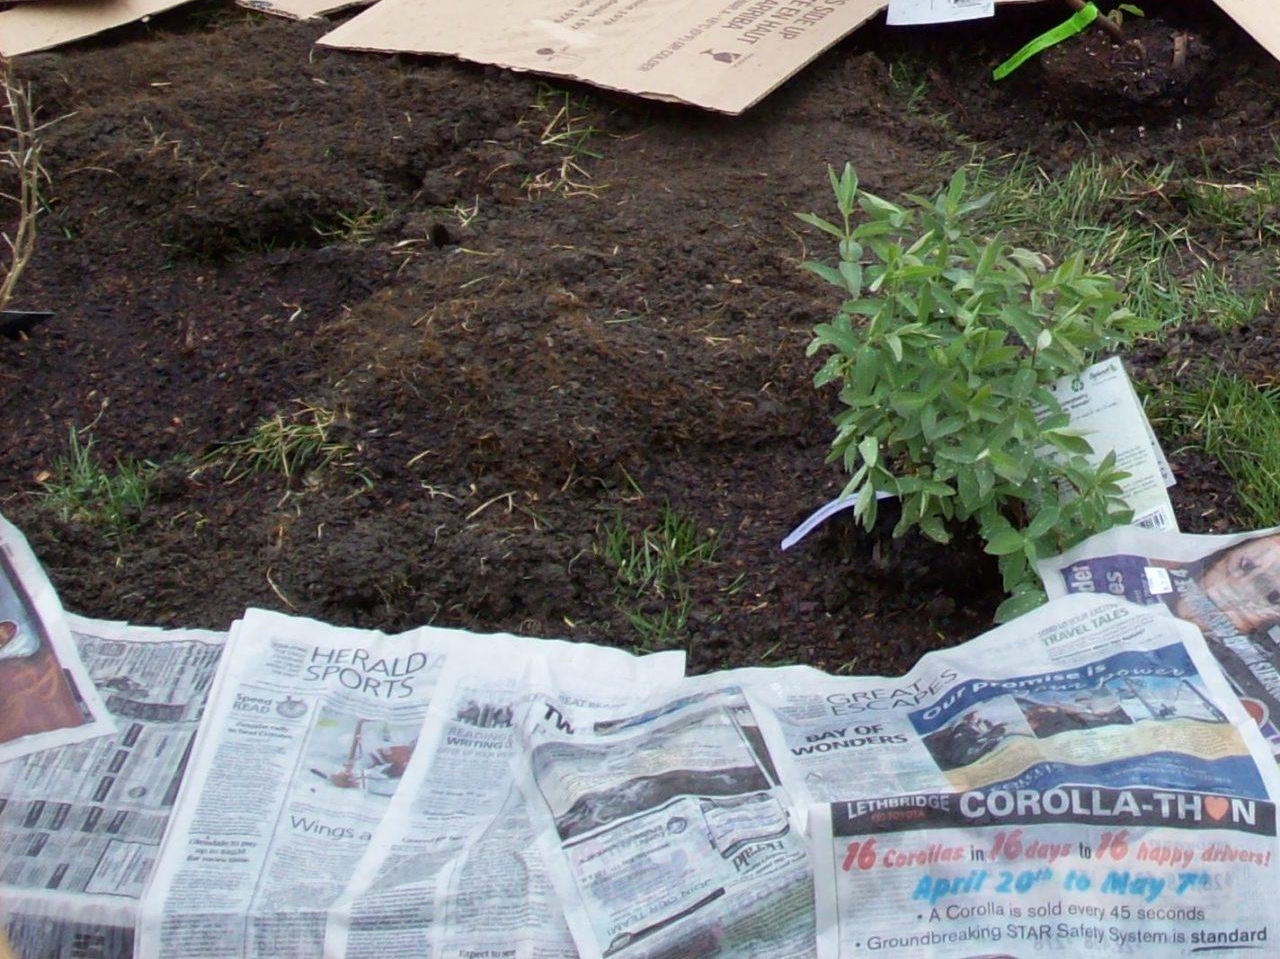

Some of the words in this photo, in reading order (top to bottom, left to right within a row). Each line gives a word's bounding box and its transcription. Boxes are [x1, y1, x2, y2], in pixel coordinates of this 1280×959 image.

[770, 6, 801, 21] EN
[793, 5, 835, 27] SIDE
[737, 19, 783, 45] HAUT
[779, 25, 806, 40] UP
[1043, 623, 1091, 647] TRAVEL
[1091, 607, 1130, 629] TALES
[311, 646, 428, 678] HERALD
[303, 664, 415, 700] SPORTS
[826, 680, 922, 706] GREAT
[830, 666, 959, 717] ESCAPES
[922, 682, 971, 721] Our
[1086, 662, 1107, 679] is
[236, 692, 274, 706] Speed
[791, 732, 909, 757] WONDERS
[804, 725, 851, 743] BAY
[853, 722, 886, 738] OF
[847, 793, 952, 821] LETHBRIDGE
[290, 814, 356, 841] Wings
[734, 840, 786, 872] Herald
[841, 837, 877, 873] 16
[882, 844, 966, 869] Corollas
[969, 845, 984, 862] in
[988, 828, 1024, 861] 16
[1025, 841, 1073, 864] days
[1078, 841, 1092, 859] to
[1094, 829, 1131, 862] 16
[1136, 841, 1195, 869] happy
[1200, 842, 1273, 867] drivers!
[911, 869, 990, 905] April
[1064, 868, 1092, 892] to
[1099, 869, 1167, 904] May
[928, 909, 942, 924] A
[945, 901, 1005, 922] Corolla
[1008, 903, 1023, 918] is
[1026, 900, 1063, 919] sold
[1067, 902, 1106, 922] every
[1110, 905, 1132, 921] 45
[1136, 905, 1207, 922] seconds
[866, 924, 1002, 952] Groundbreaking
[1006, 922, 1053, 941] STAR
[1056, 923, 1105, 944] Safety
[1108, 927, 1169, 945] System
[1172, 932, 1187, 944] is
[1190, 926, 1268, 945] standard
